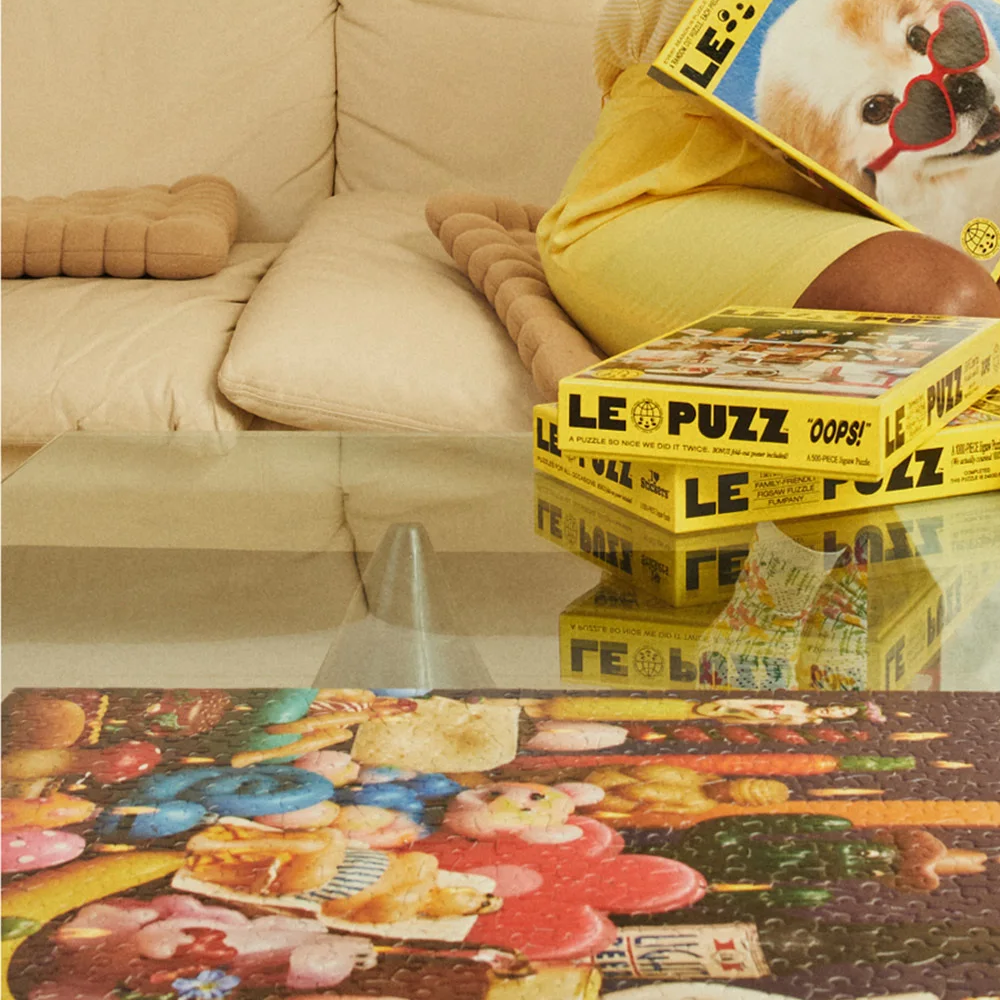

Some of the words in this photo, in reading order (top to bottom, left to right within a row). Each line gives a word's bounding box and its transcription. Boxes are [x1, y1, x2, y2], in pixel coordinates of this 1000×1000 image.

[680, 27, 735, 89] LE
[569, 394, 626, 431] LE
[668, 401, 789, 444] PUZZ
[885, 405, 905, 458] LE
[927, 365, 962, 427] PUZZ
[537, 417, 562, 457] LE
[683, 445, 710, 453] TWICE.
[686, 472, 748, 518] LE
